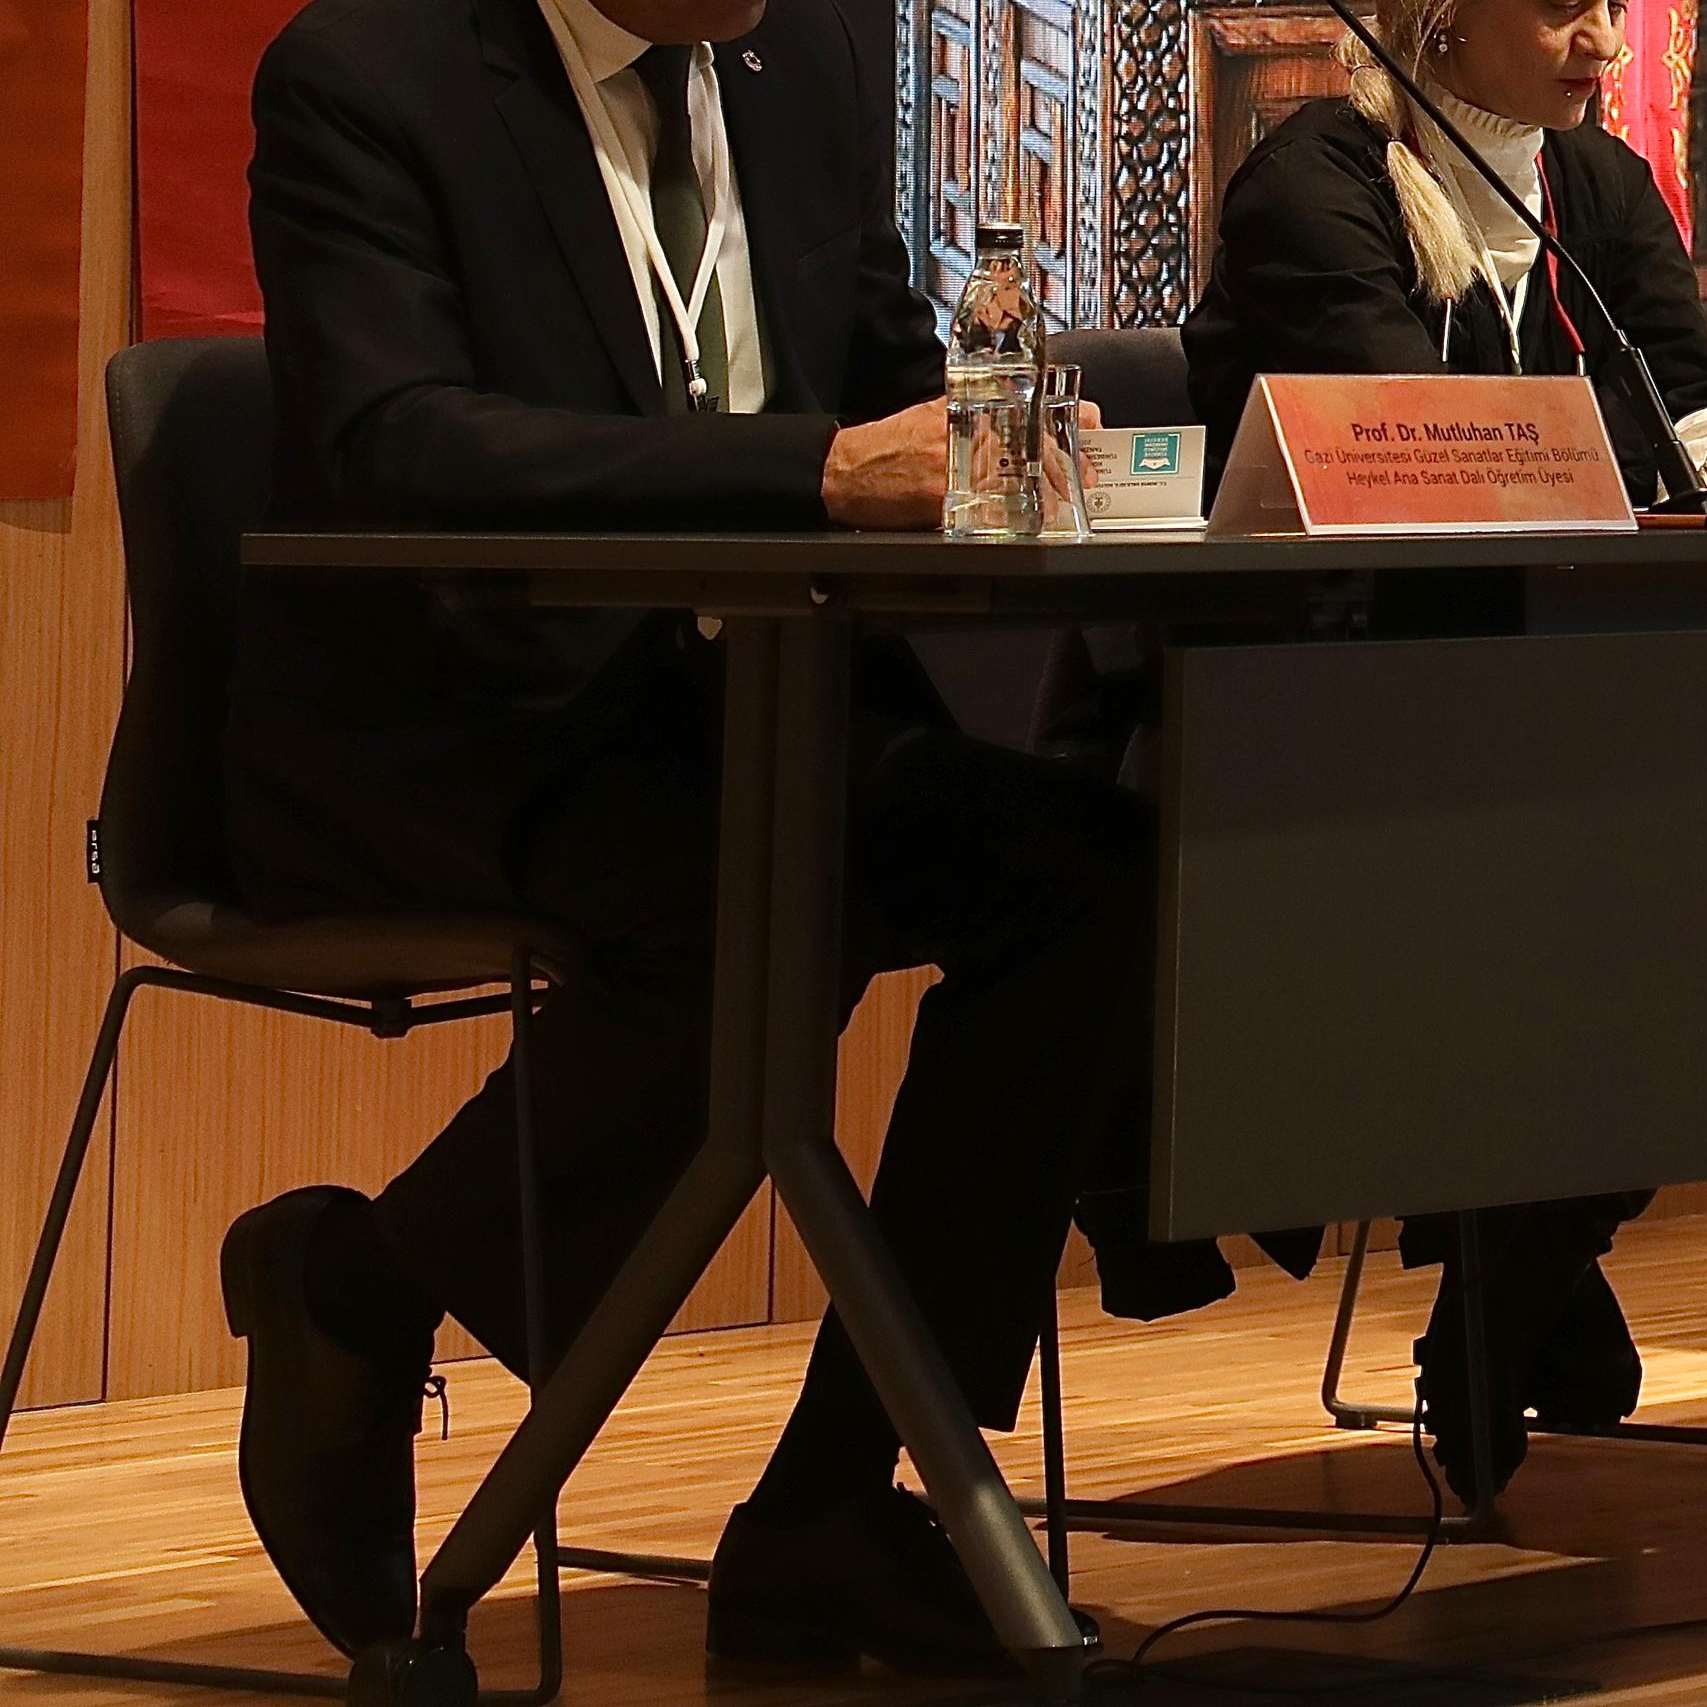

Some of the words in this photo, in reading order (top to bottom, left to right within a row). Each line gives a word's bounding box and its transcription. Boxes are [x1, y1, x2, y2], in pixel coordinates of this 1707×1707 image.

[1351, 422, 1394, 442] Prof.
[1400, 424, 1421, 442] Dr.
[1425, 422, 1503, 442] Mutluhan
[1504, 422, 1540, 445] TAŞ
[1336, 446, 1412, 463] Üniversitesi
[1414, 448, 1450, 463] Güzel
[1452, 448, 1503, 463] Sanatlar
[1506, 447, 1549, 465] Eğitimi
[1552, 448, 1599, 463] Bölümü
[1347, 470, 1391, 488] Heykel
[1393, 470, 1418, 484] Ana
[1421, 470, 1459, 485] Sanat
[1461, 470, 1485, 484] Dalı
[1487, 467, 1536, 488] Öğretim
[1540, 467, 1574, 488] Üyesi
